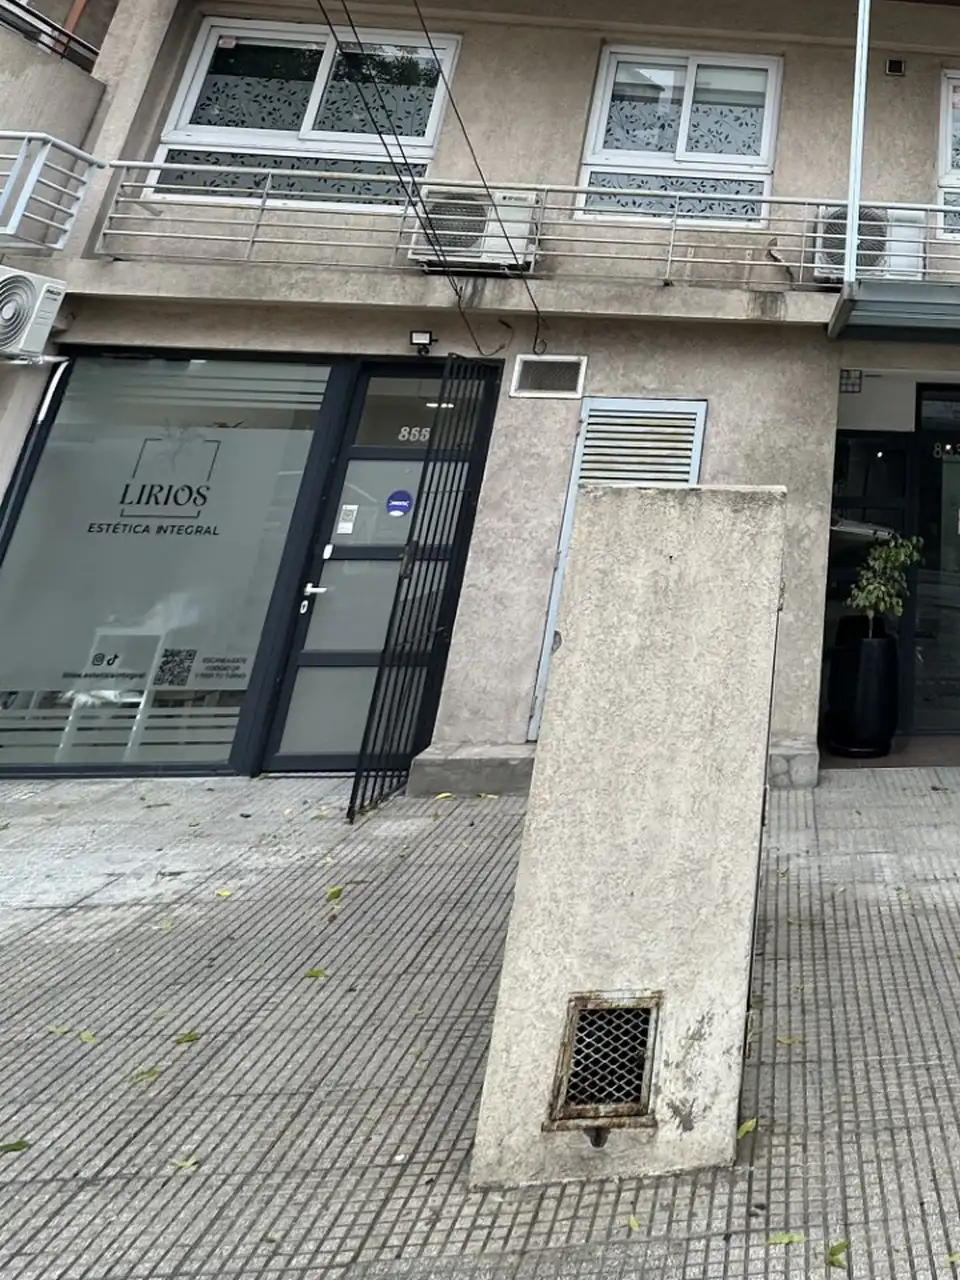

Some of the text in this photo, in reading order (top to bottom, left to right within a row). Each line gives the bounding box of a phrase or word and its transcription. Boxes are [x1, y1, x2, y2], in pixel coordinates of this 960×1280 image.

[119, 483, 210, 507] LIRIOS
[87, 521, 219, 536] ESTÉTICA INTEGRAL
